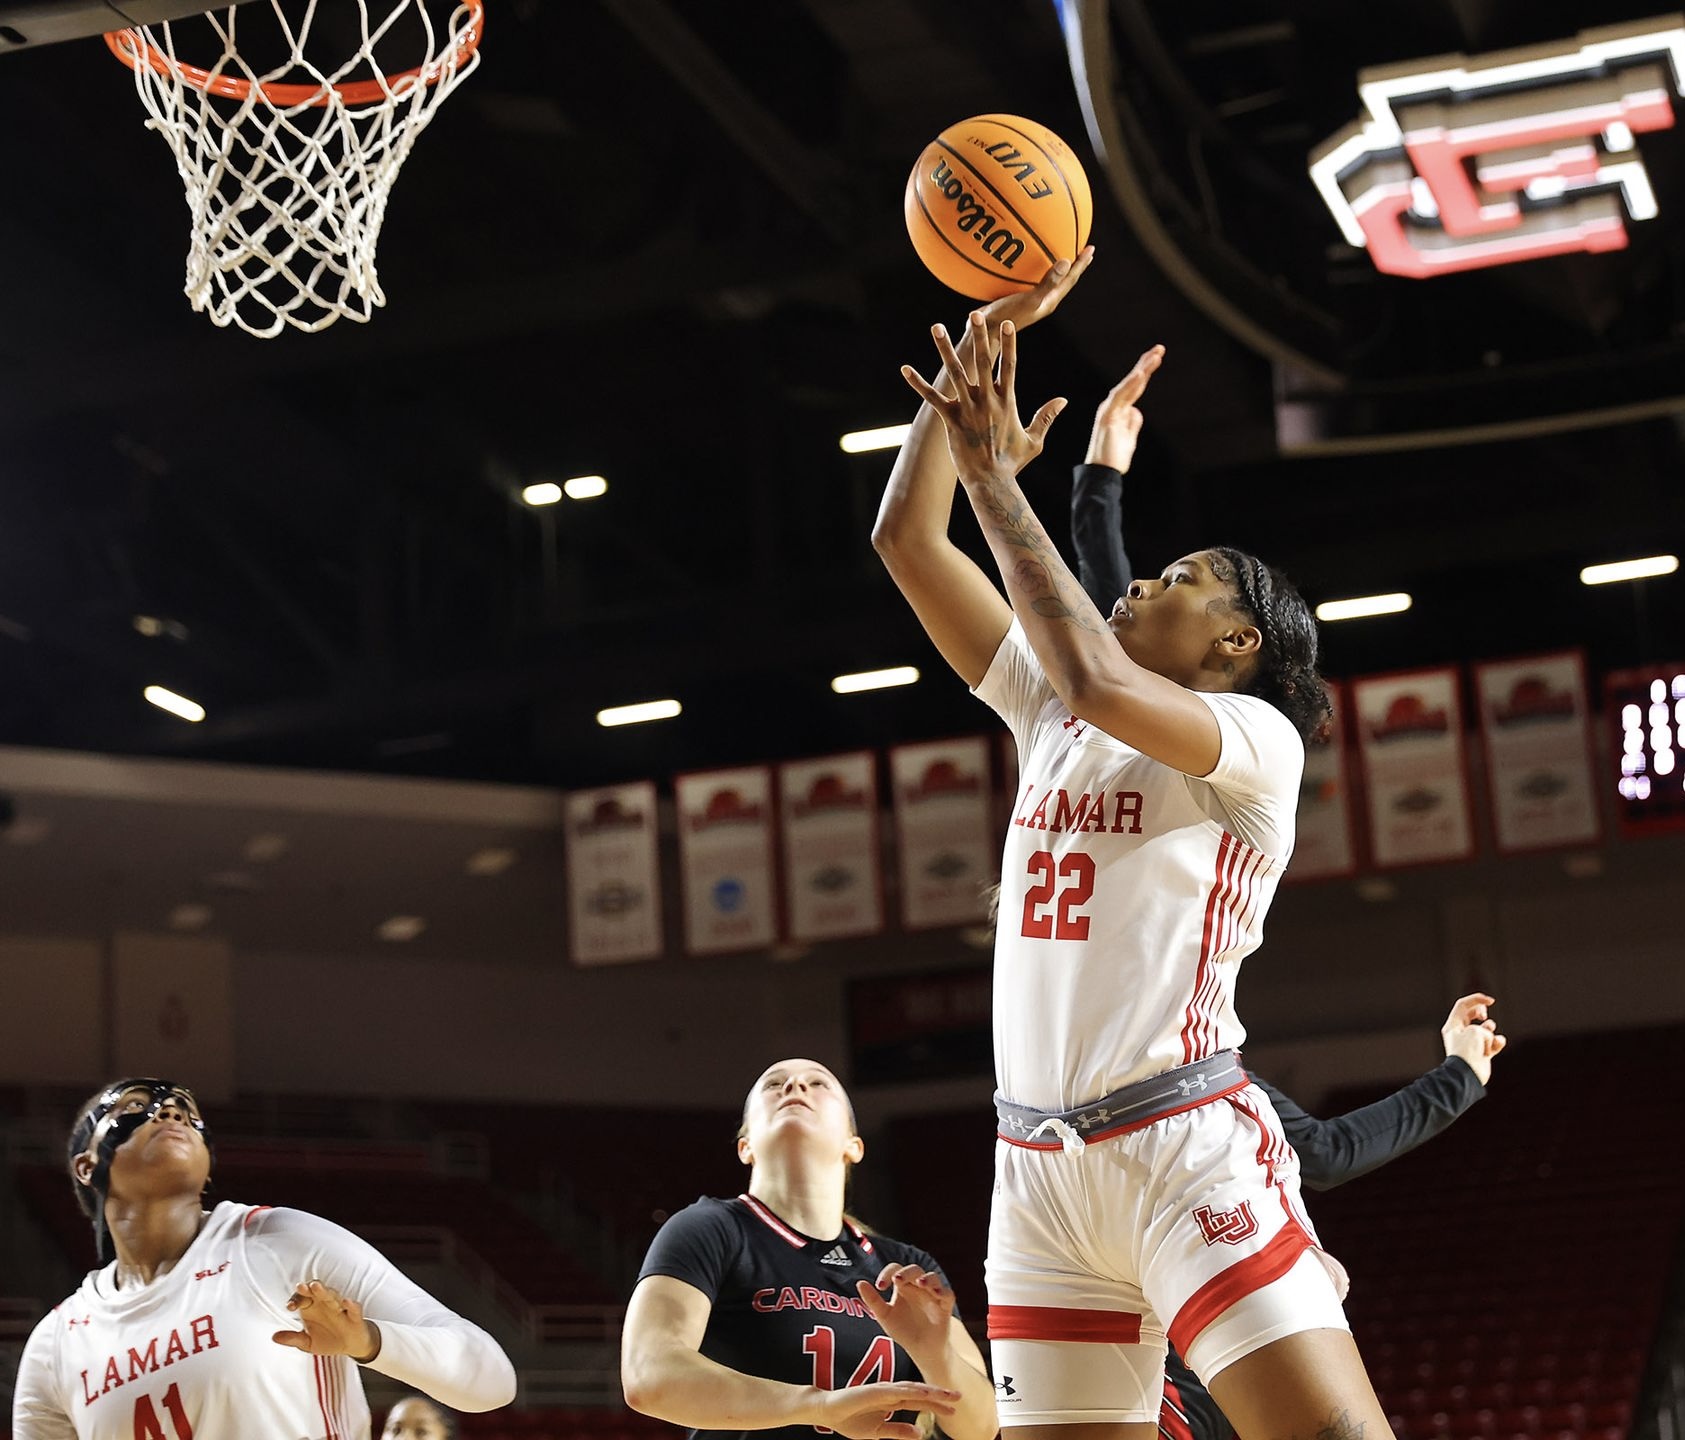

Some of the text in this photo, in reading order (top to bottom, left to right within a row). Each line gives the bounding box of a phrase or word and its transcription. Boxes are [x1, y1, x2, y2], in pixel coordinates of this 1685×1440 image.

[984, 141, 1053, 200] EVO
[930, 159, 1026, 270] Wilson
[1014, 784, 1143, 834] LAMAR
[1020, 850, 1097, 941] 22
[1193, 1199, 1259, 1248] LU
[820, 1257, 853, 1267] adidas
[752, 1286, 877, 1320] CARDIN
[80, 1314, 220, 1406] LAMAR
[803, 1325, 897, 1434] 14
[133, 1382, 194, 1440] 41
